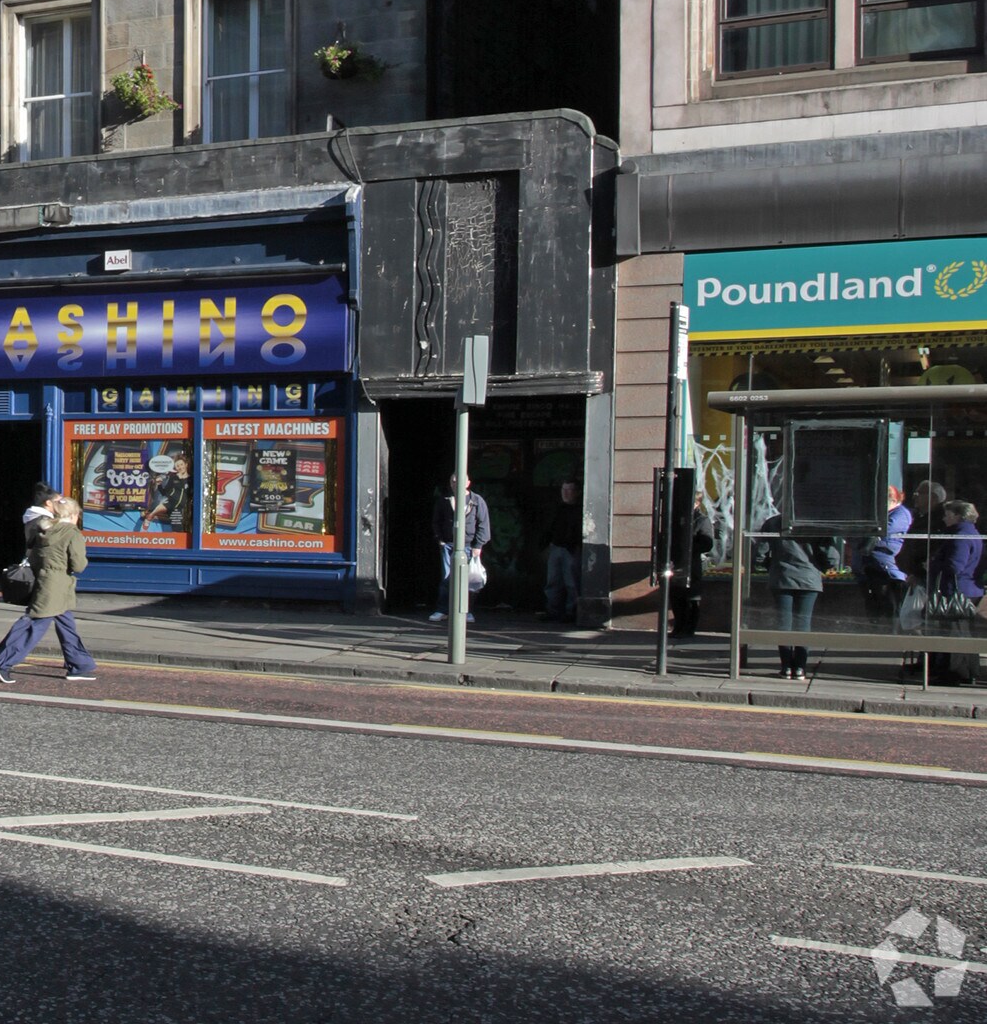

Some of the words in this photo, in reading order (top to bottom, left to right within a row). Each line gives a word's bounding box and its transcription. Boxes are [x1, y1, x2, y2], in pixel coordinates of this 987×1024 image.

[106, 255, 128, 266] Abel
[697, 267, 922, 307] Poundland
[101, 383, 302, 404] GAMING
[74, 424, 96, 435] FREE
[98, 423, 121, 435] PLAY
[123, 422, 183, 435] PROMOTIONS
[215, 423, 261, 436] LATEST
[264, 422, 330, 435] MACHINES
[258, 457, 288, 465] GAME
[283, 519, 315, 531] BAR
[218, 537, 324, 549] www.cashino.com
